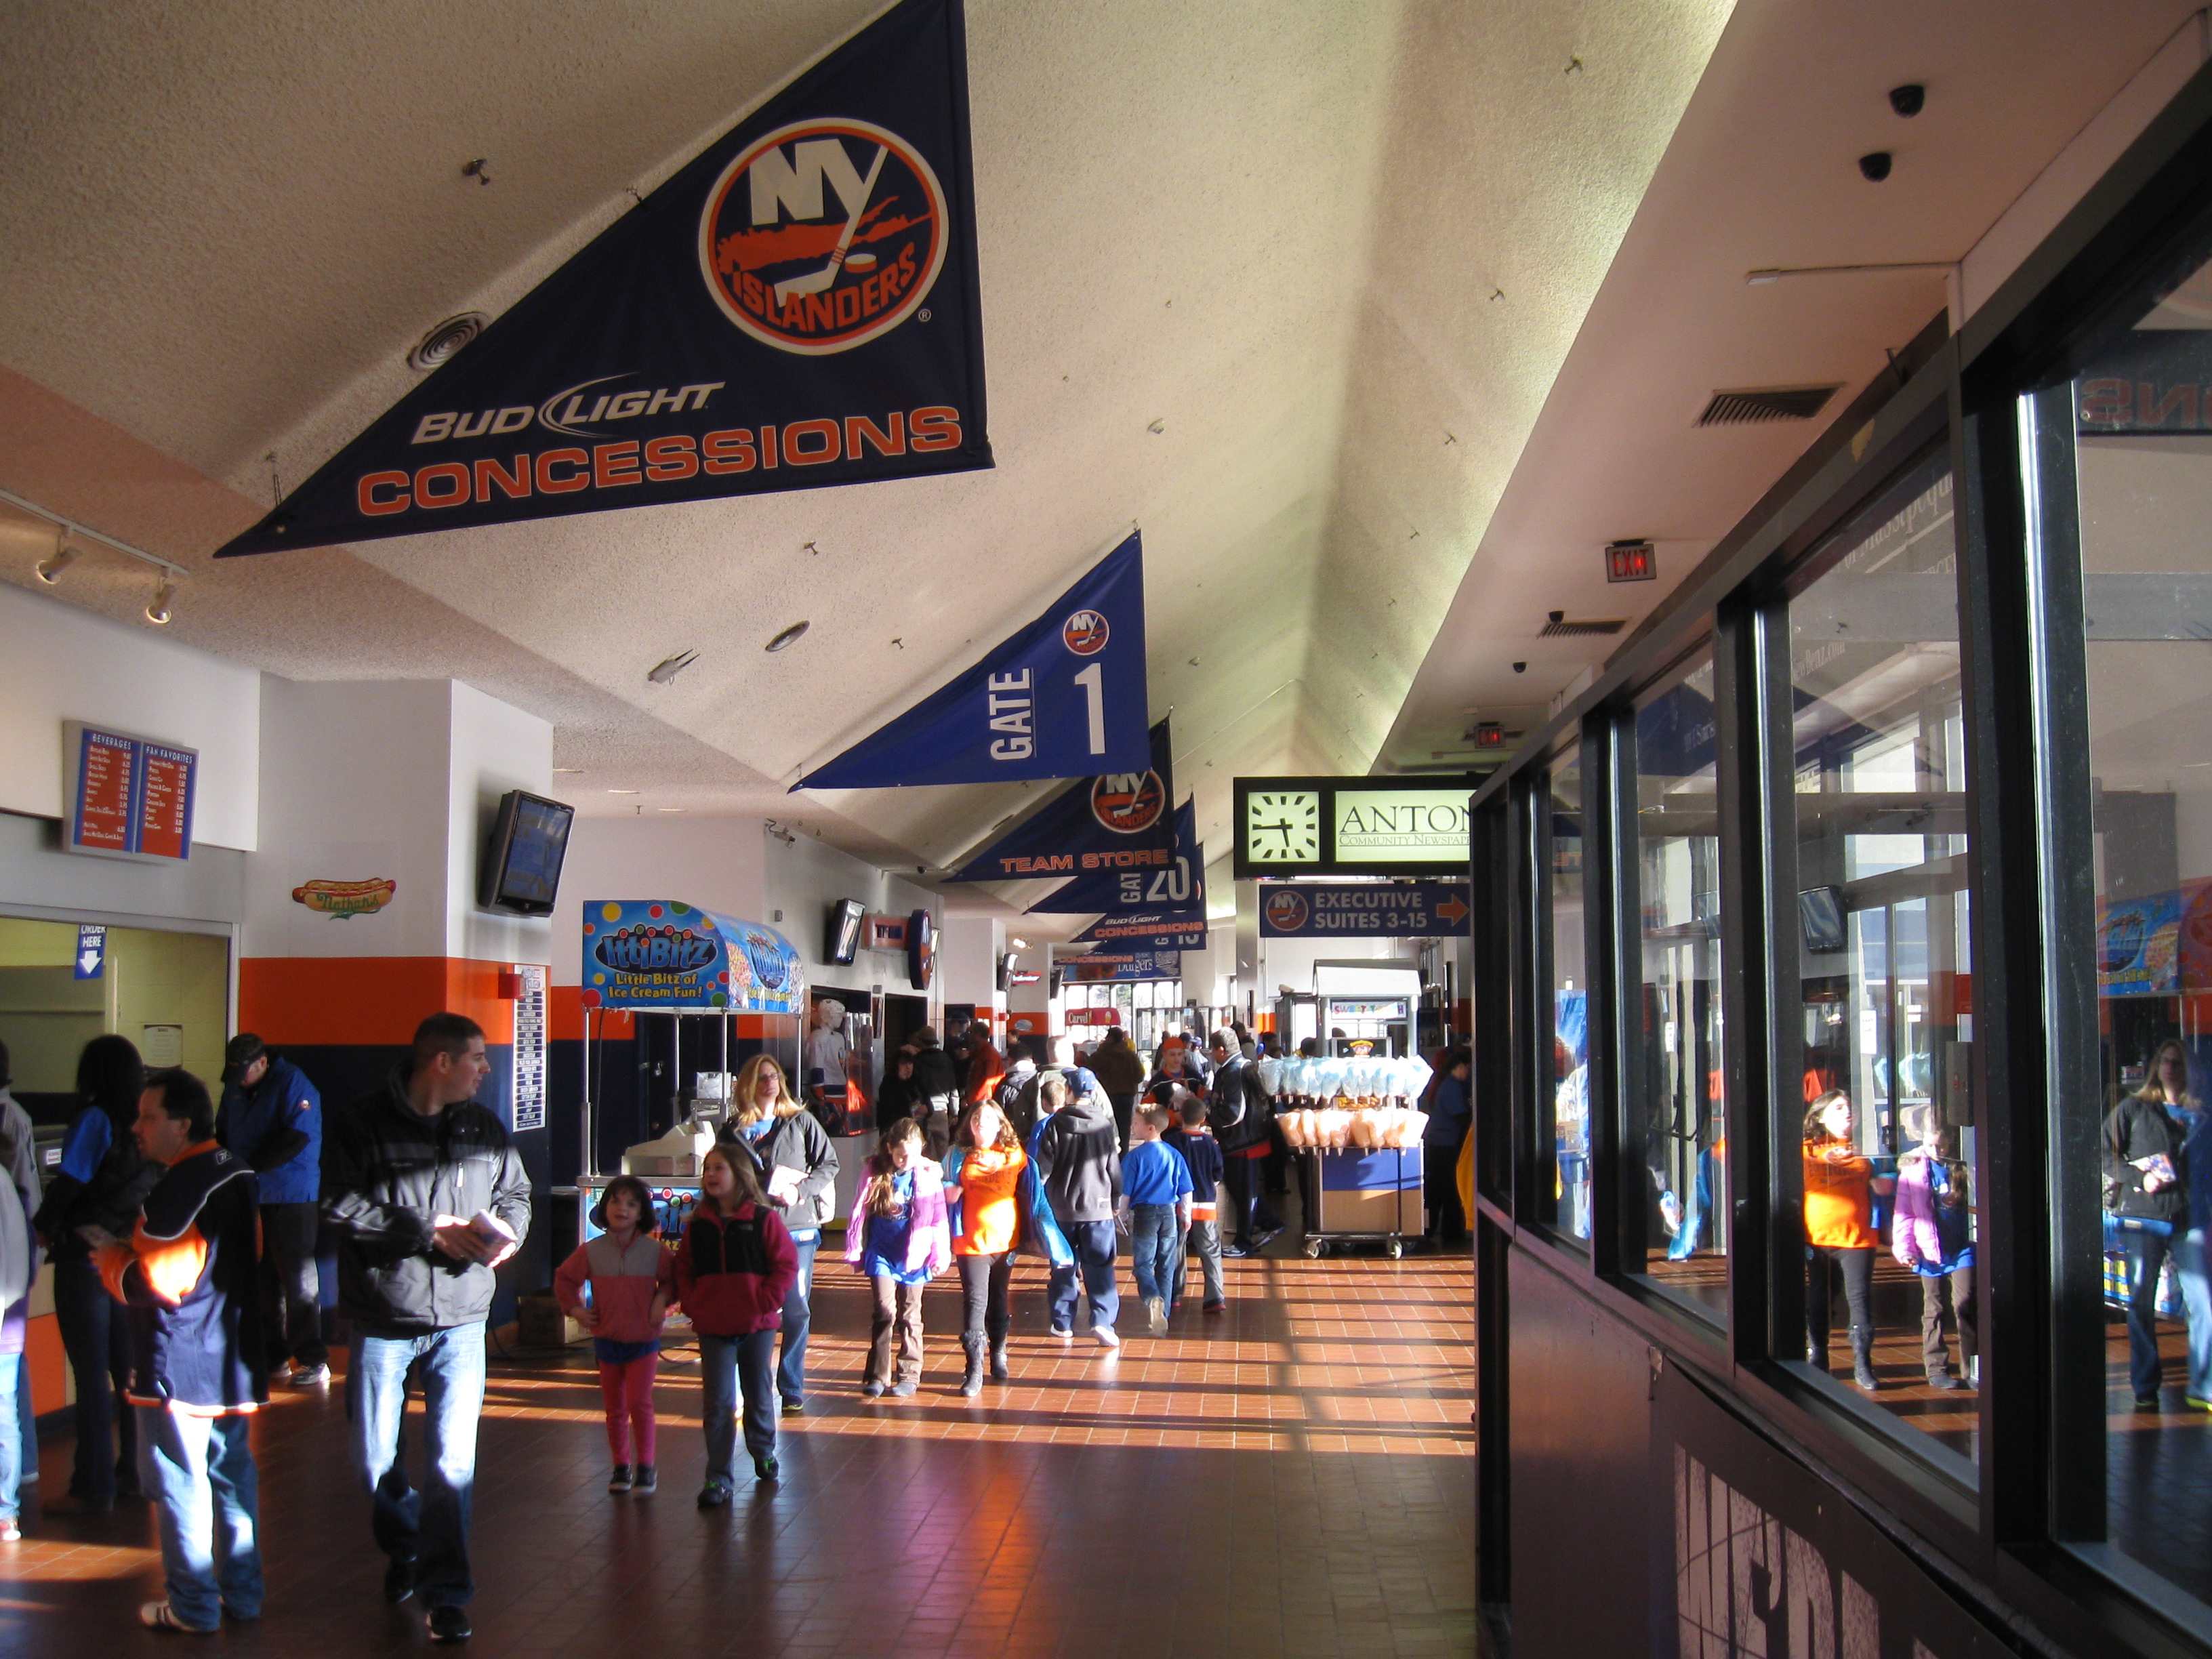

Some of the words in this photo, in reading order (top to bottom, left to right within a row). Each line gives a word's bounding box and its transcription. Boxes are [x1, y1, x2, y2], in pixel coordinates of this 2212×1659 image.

[750, 137, 889, 227] NY
[732, 242, 917, 332] ISLANDERS
[410, 405, 539, 445] BUD
[562, 382, 726, 424] LIGHT
[357, 406, 963, 516] CONCESSIONS
[1612, 548, 1649, 577] EXIT
[989, 668, 1033, 761] GATE
[1074, 662, 1106, 755] 1
[93, 733, 131, 750] BEVERAGES
[1477, 728, 1502, 746] EXIT
[146, 745, 159, 756] FAN
[161, 749, 193, 764] FAVORITES
[1339, 835, 1410, 845] COMMUNITY
[1000, 855, 1073, 873] TEAM
[1082, 849, 1169, 868] STORE
[1120, 872, 1141, 903] GAT
[1146, 856, 1191, 902] 20
[316, 893, 379, 911] Nathan's
[1315, 892, 1422, 908] EXECUTIVE
[1132, 915, 1163, 924] LIGHT
[1315, 912, 1380, 928] SUITES
[1387, 912, 1428, 928] 3-15
[1094, 921, 1205, 939] CONCESSIONS
[83, 936, 102, 947] HERE
[615, 972, 649, 985] Little
[652, 972, 680, 985] Bitz
[683, 972, 697, 985] of
[608, 986, 628, 998] Ice
[630, 986, 671, 998] Cream
[674, 985, 702, 998] Fun!
[1068, 1011, 1088, 1024] Carvel
